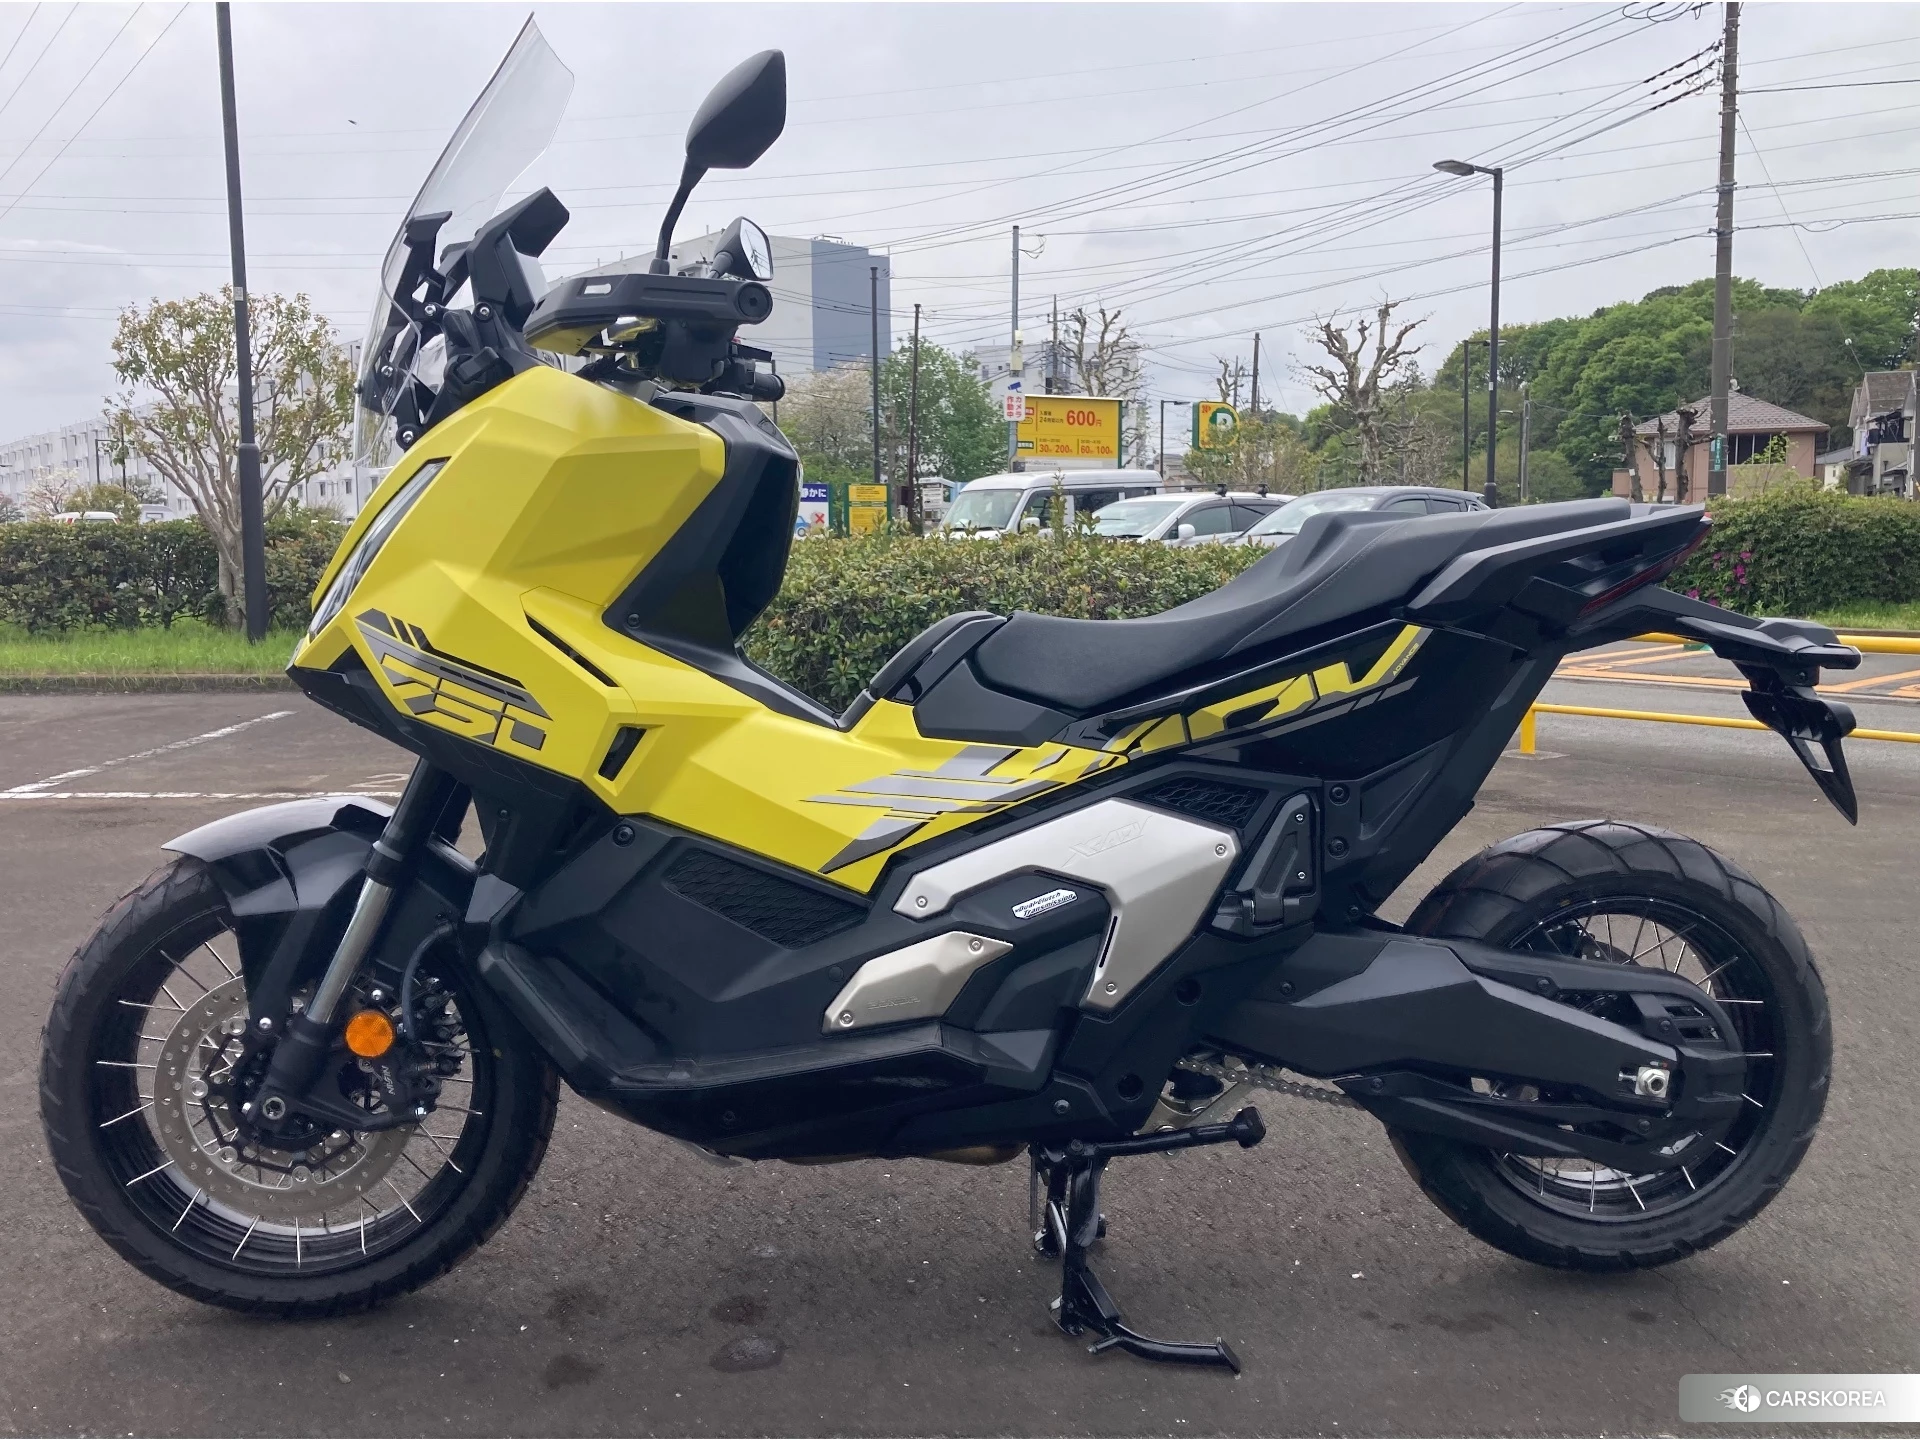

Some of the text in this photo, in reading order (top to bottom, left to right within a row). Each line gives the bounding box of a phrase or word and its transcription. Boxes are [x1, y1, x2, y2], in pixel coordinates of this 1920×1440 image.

[1006, 395, 1015, 418] 作動中
[1015, 396, 1023, 418] カメラ
[1392, 642, 1420, 677] ADVANCE
[1023, 893, 1074, 917] Transmission
